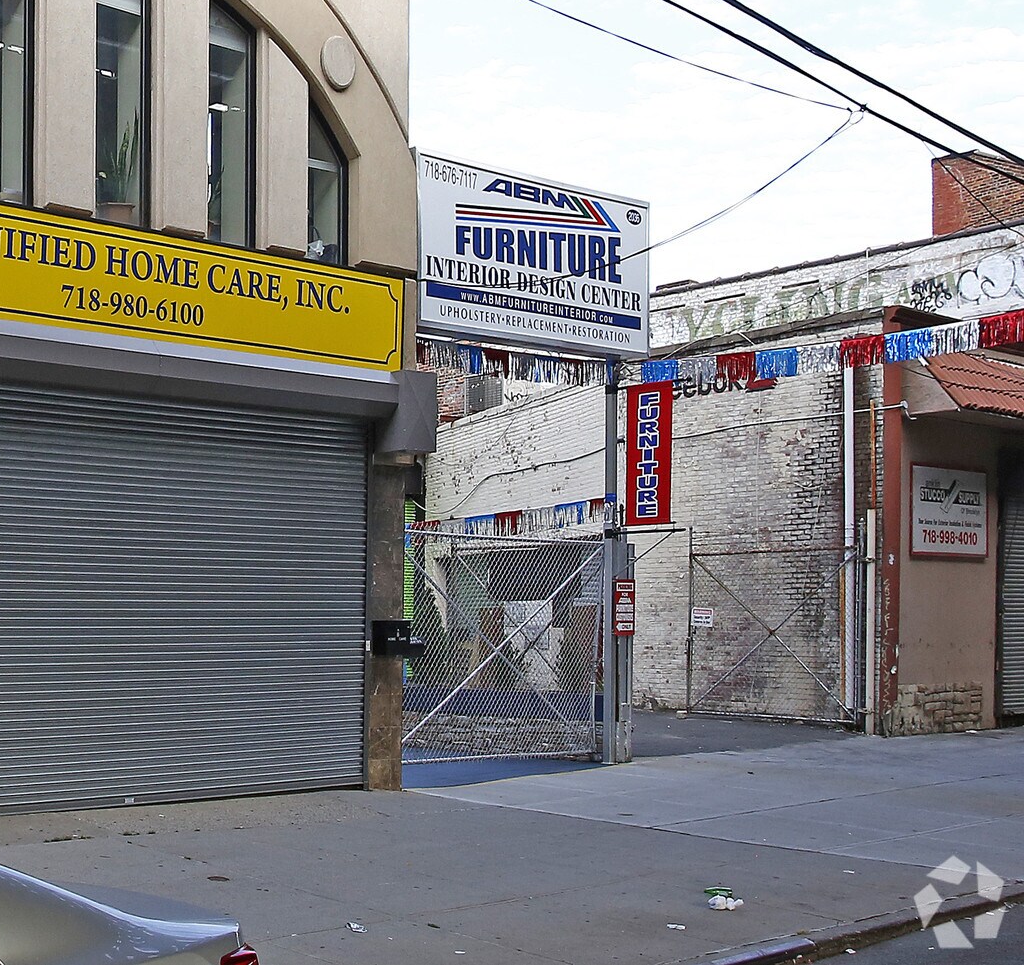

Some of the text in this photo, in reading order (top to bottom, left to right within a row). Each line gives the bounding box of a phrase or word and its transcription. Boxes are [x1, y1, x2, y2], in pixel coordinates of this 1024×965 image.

[425, 160, 477, 189] 718-676-7117
[483, 178, 577, 211] ABM
[105, 244, 200, 289] HOME
[207, 264, 289, 311] CARE,
[295, 279, 351, 314] INC.
[455, 225, 622, 284] FURNITURE
[60, 284, 204, 326] 718-980-6100
[426, 255, 641, 312] INTERIOR DESIGN CENTER
[636, 391, 661, 518] FURNITURE
[920, 488, 980, 505] STUCCO SUPPLY
